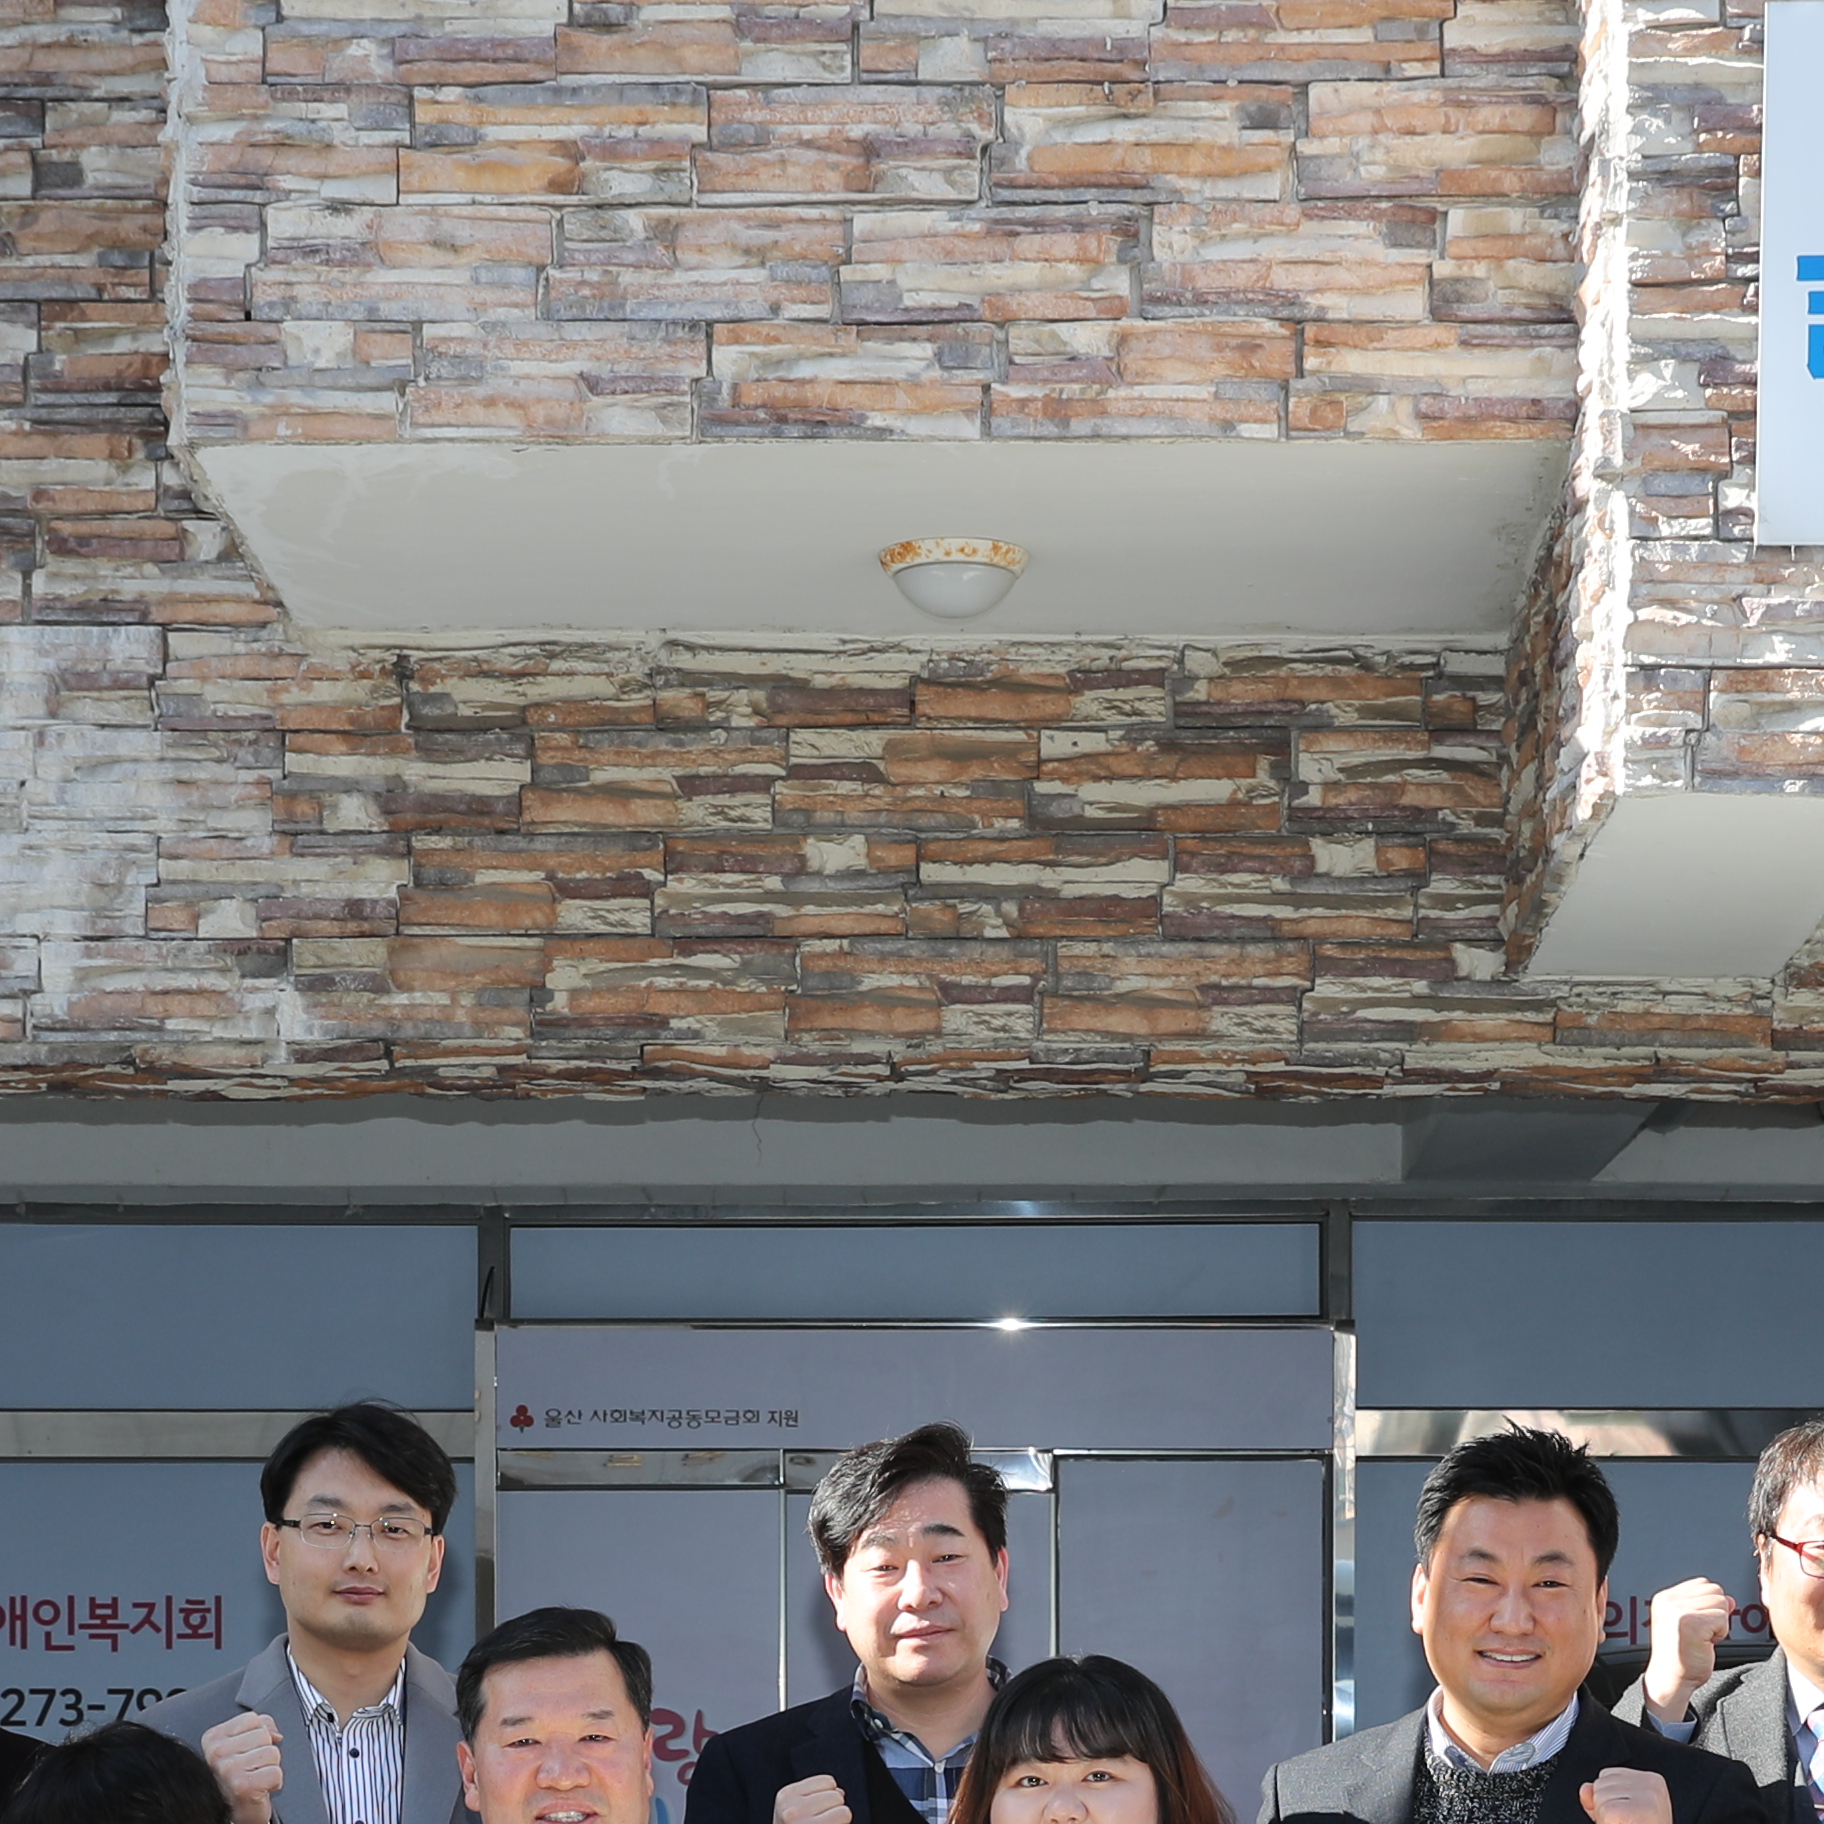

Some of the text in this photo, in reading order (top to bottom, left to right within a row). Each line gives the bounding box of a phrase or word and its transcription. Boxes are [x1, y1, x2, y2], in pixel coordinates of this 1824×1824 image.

[544, 1408, 799, 1429] 울산 사회복지공동모금회 지원
